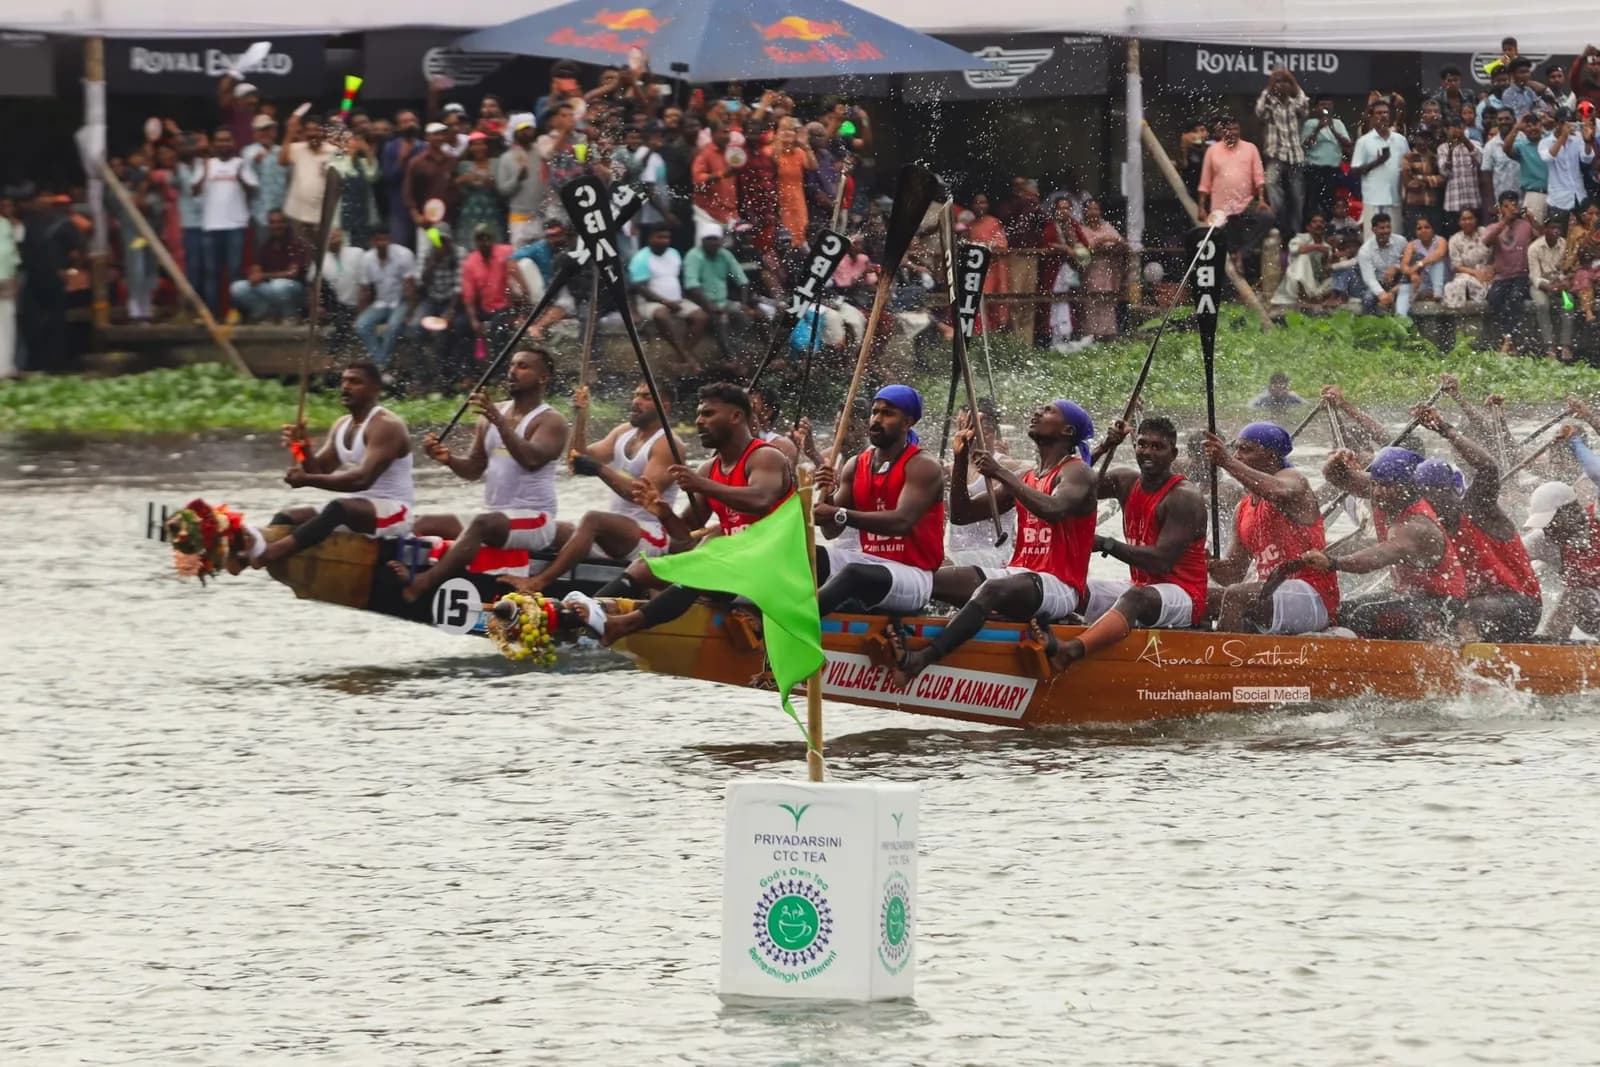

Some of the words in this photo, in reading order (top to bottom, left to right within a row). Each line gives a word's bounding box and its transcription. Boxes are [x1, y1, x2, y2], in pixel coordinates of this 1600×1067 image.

[130, 47, 203, 73] ROYAL
[1197, 49, 1258, 73] ROYAL
[1263, 51, 1339, 76] ENFIELD
[1023, 527, 1052, 543] BC
[437, 588, 469, 628] 15
[826, 661, 883, 691] VILLAGE
[880, 667, 916, 696] BT
[916, 673, 955, 700] CLUB
[950, 678, 1029, 711] KAINAKARY
[754, 834, 842, 848] PRIYADARSINI
[773, 850, 799, 861] CTC
[803, 852, 827, 862] TEA
[760, 869, 787, 888] God's
[789, 867, 812, 879] Own
[749, 947, 800, 983] Refreshingly
[801, 950, 837, 980] Different
